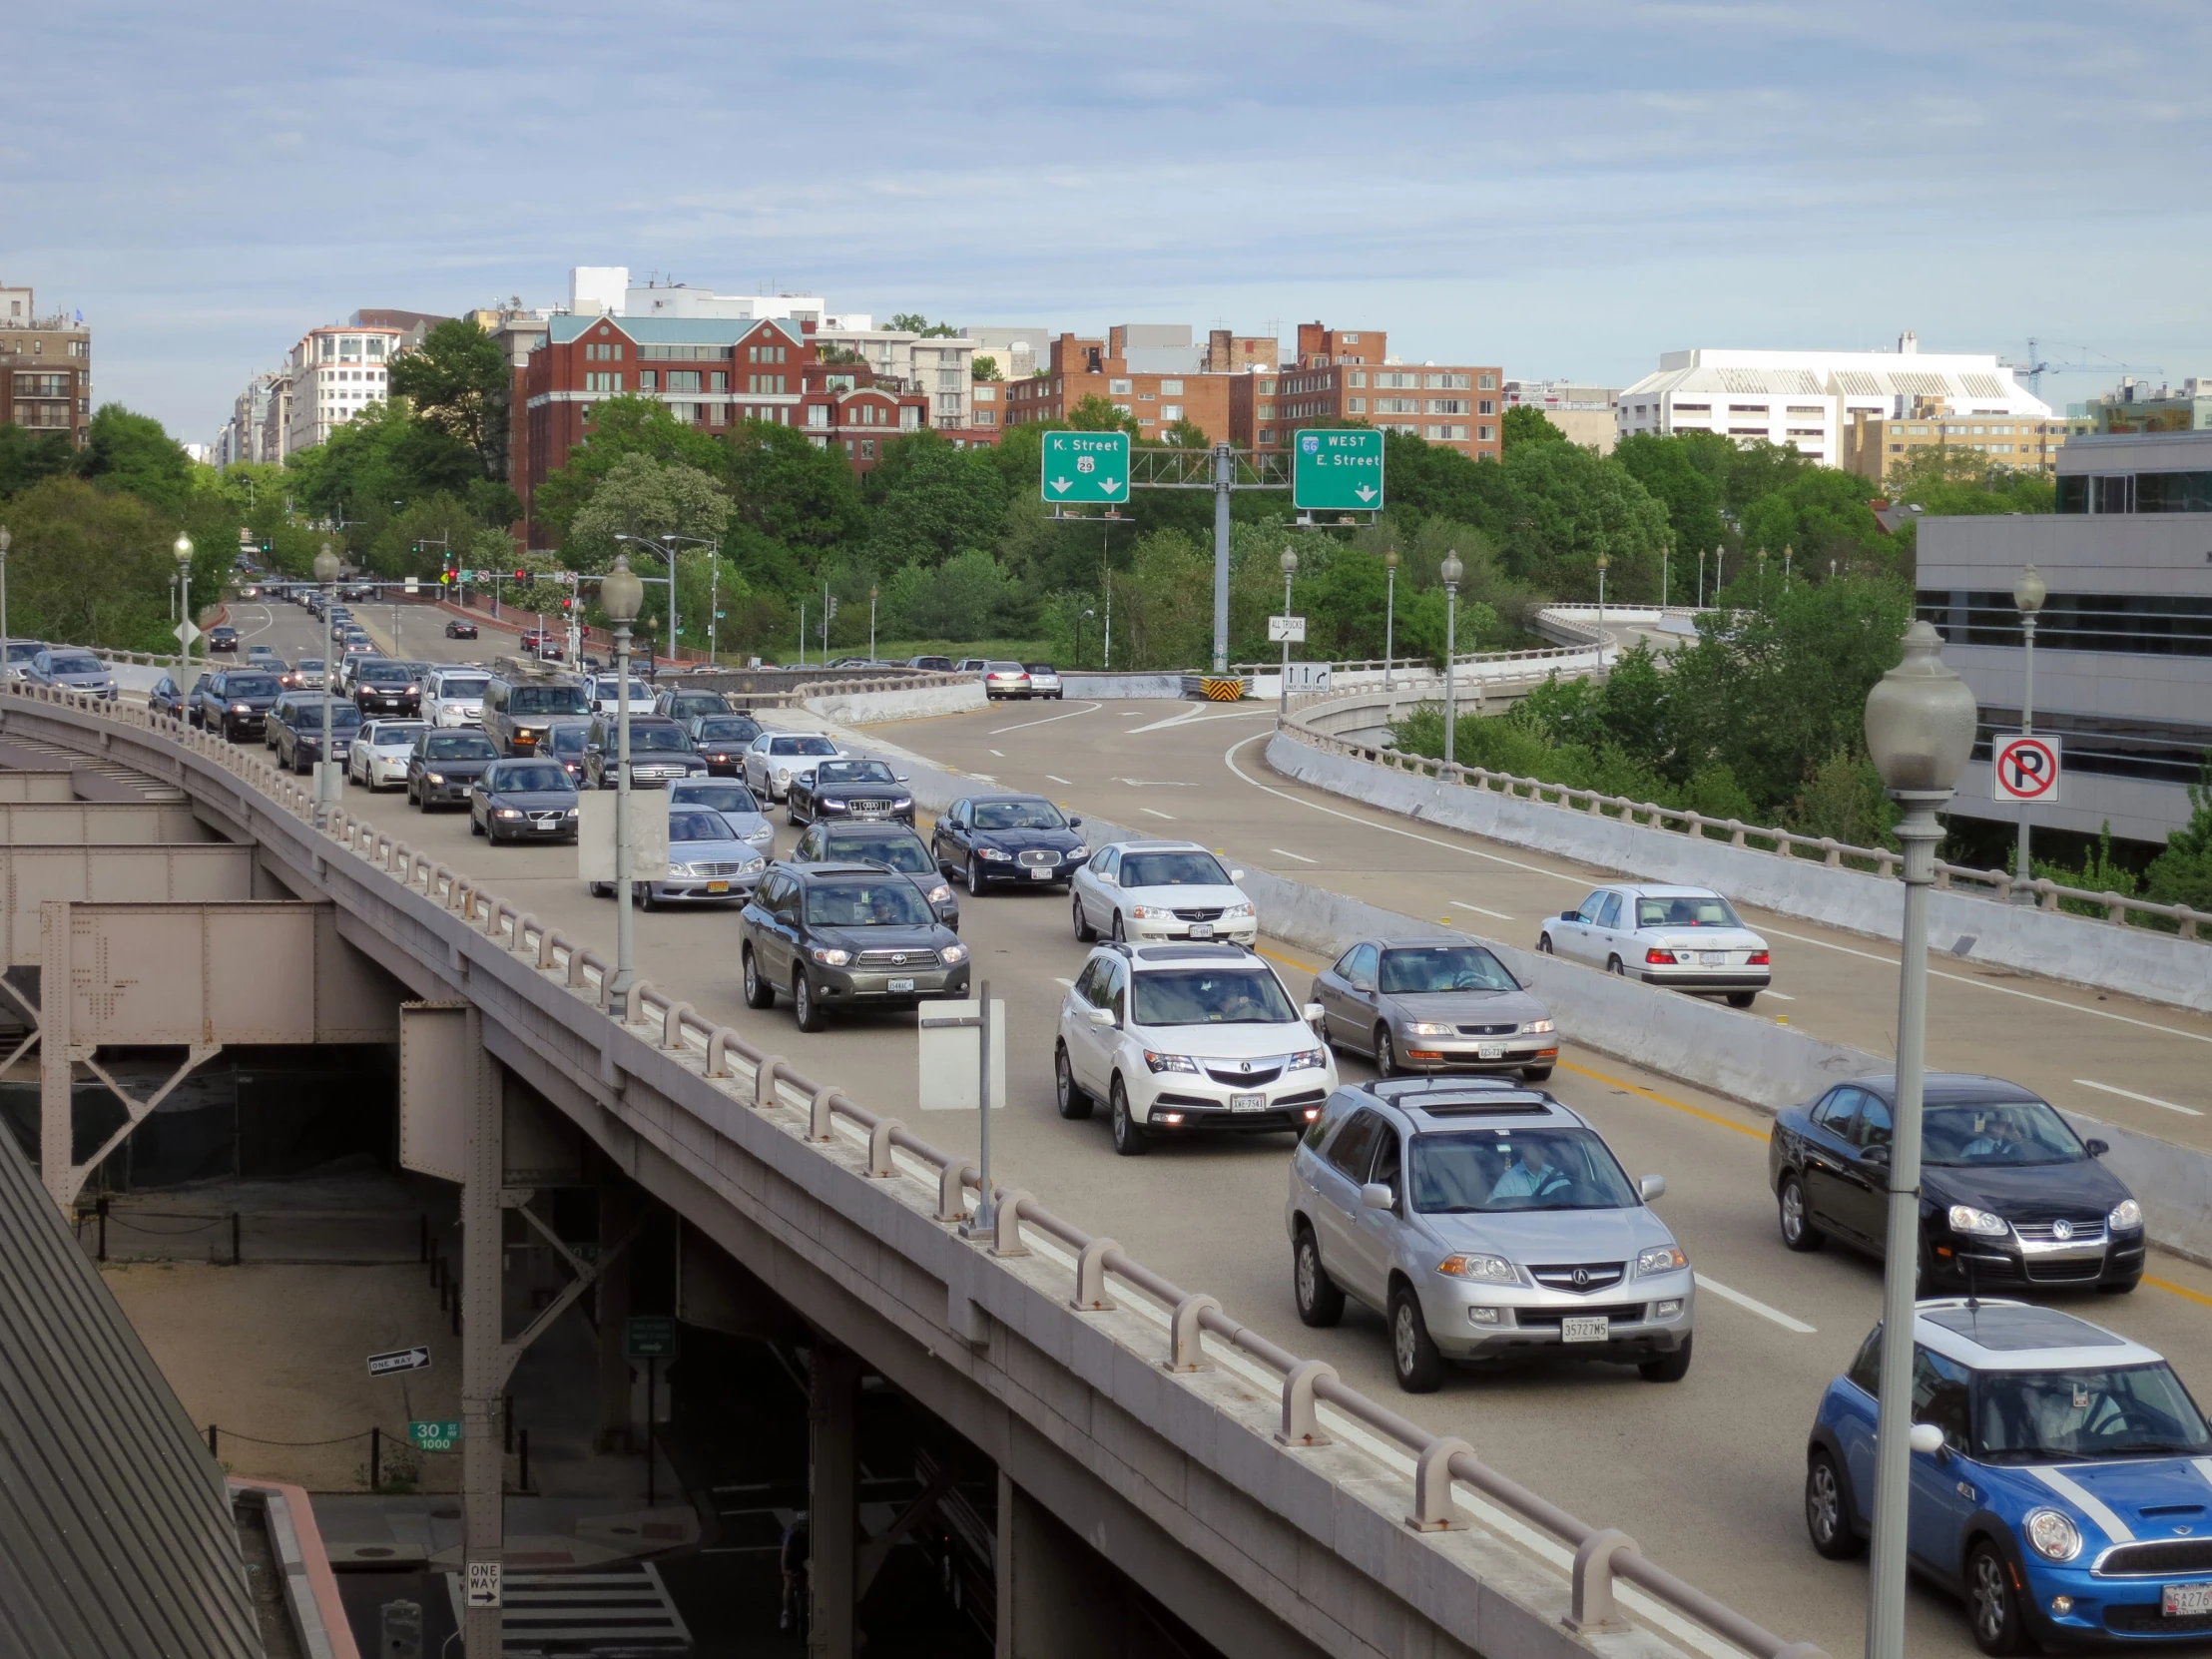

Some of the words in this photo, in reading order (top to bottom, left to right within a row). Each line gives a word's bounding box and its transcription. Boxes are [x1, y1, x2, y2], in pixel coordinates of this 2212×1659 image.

[1072, 439, 1119, 451] Street
[1303, 440, 1318, 451] 66
[1328, 435, 1367, 447] WEST
[1334, 454, 1380, 466] Street
[1079, 462, 1093, 471] 29
[1271, 619, 1281, 629] ALL
[1282, 619, 1304, 630] TRUCKS
[2014, 750, 2043, 788] P
[1565, 1323, 1606, 1337] 35727M5
[371, 1360, 389, 1370] ONE
[394, 1356, 412, 1366] WAY
[417, 1423, 440, 1437] 30
[422, 1439, 450, 1449] 1000
[471, 1565, 497, 1576] ONE
[470, 1578, 498, 1589] WAY
